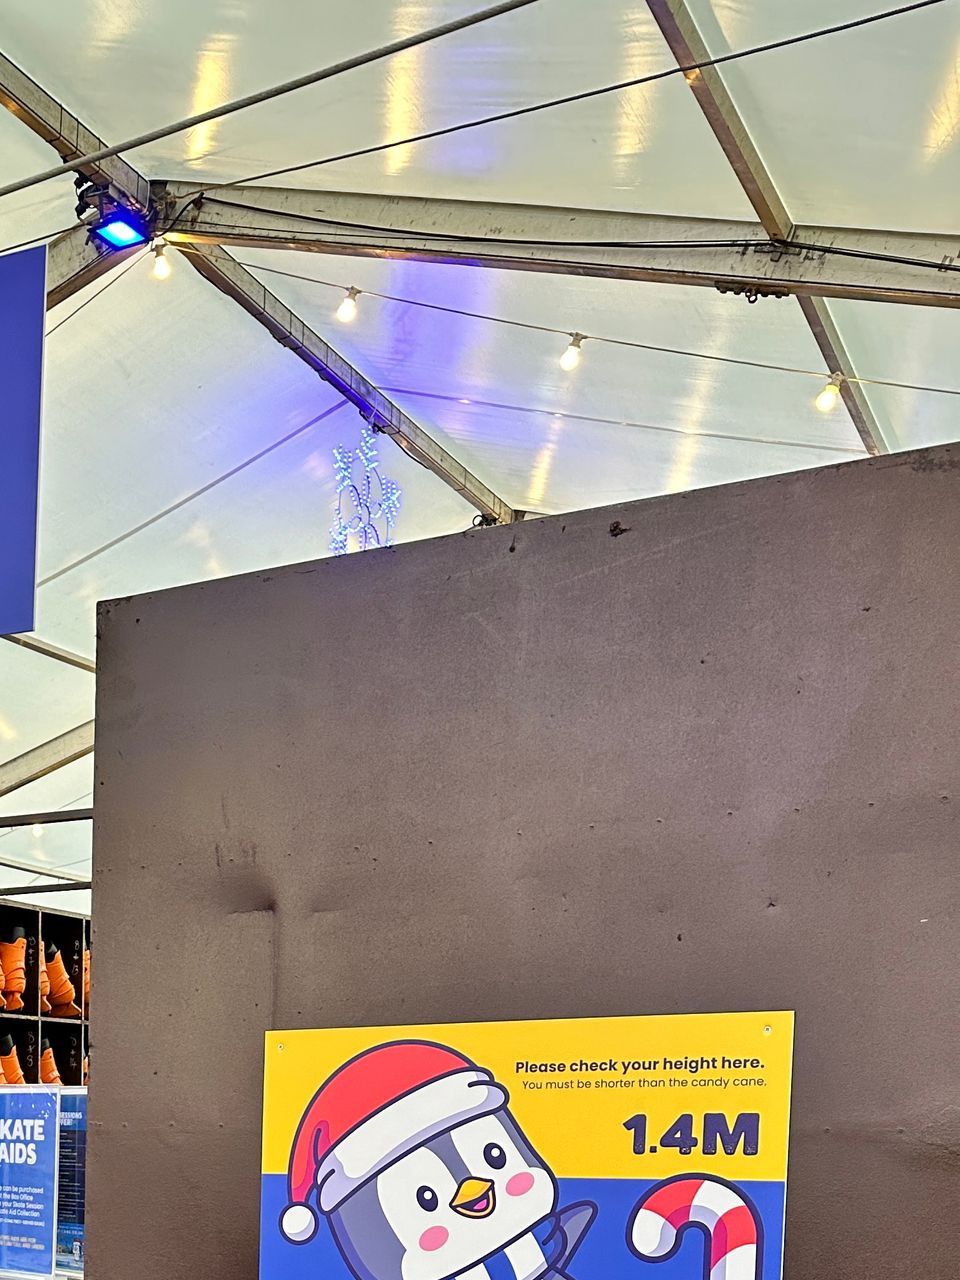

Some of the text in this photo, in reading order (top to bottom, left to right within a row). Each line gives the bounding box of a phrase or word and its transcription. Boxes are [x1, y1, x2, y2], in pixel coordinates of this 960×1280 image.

[515, 1056, 765, 1075] Please check your height here.
[522, 1076, 767, 1090] You must be shorter than the candy cane.
[623, 1112, 760, 1155] 1.4M
[17, 1209, 40, 1218] Collection
